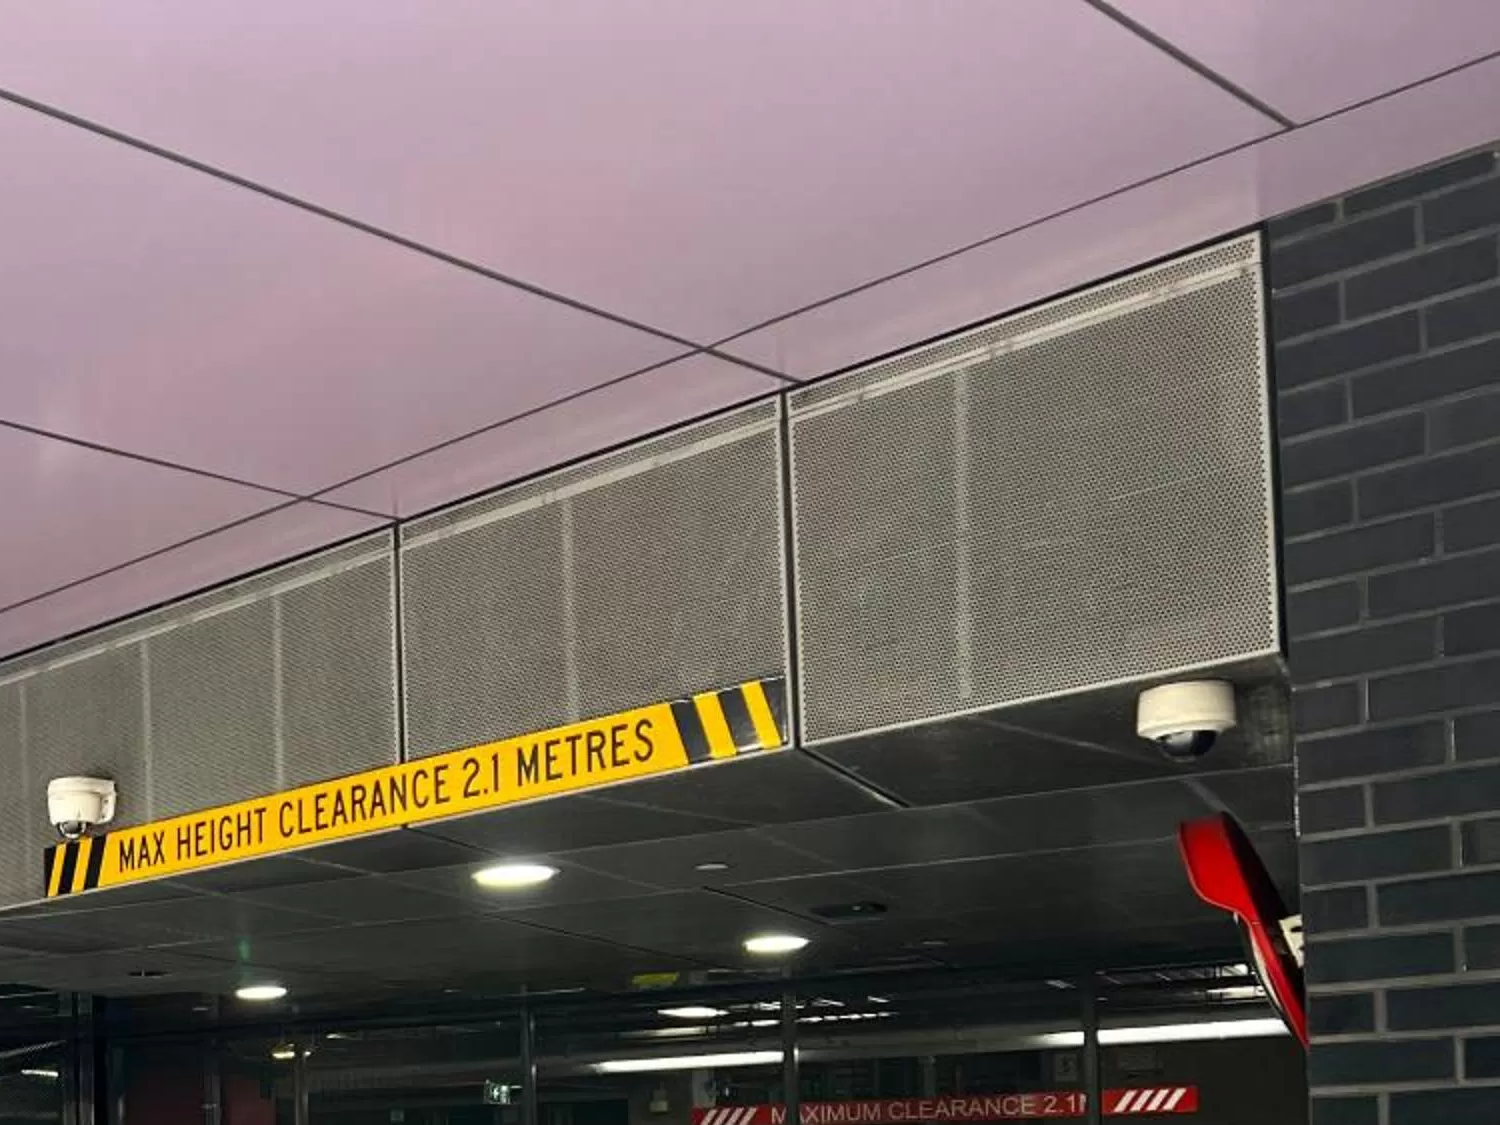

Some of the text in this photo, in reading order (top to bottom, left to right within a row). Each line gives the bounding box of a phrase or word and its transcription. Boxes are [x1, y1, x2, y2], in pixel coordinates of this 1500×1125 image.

[119, 718, 654, 872] MAX HEIGHT CLEARANCE 2.1 METRES
[888, 1096, 1037, 1121] CLEARANCE
